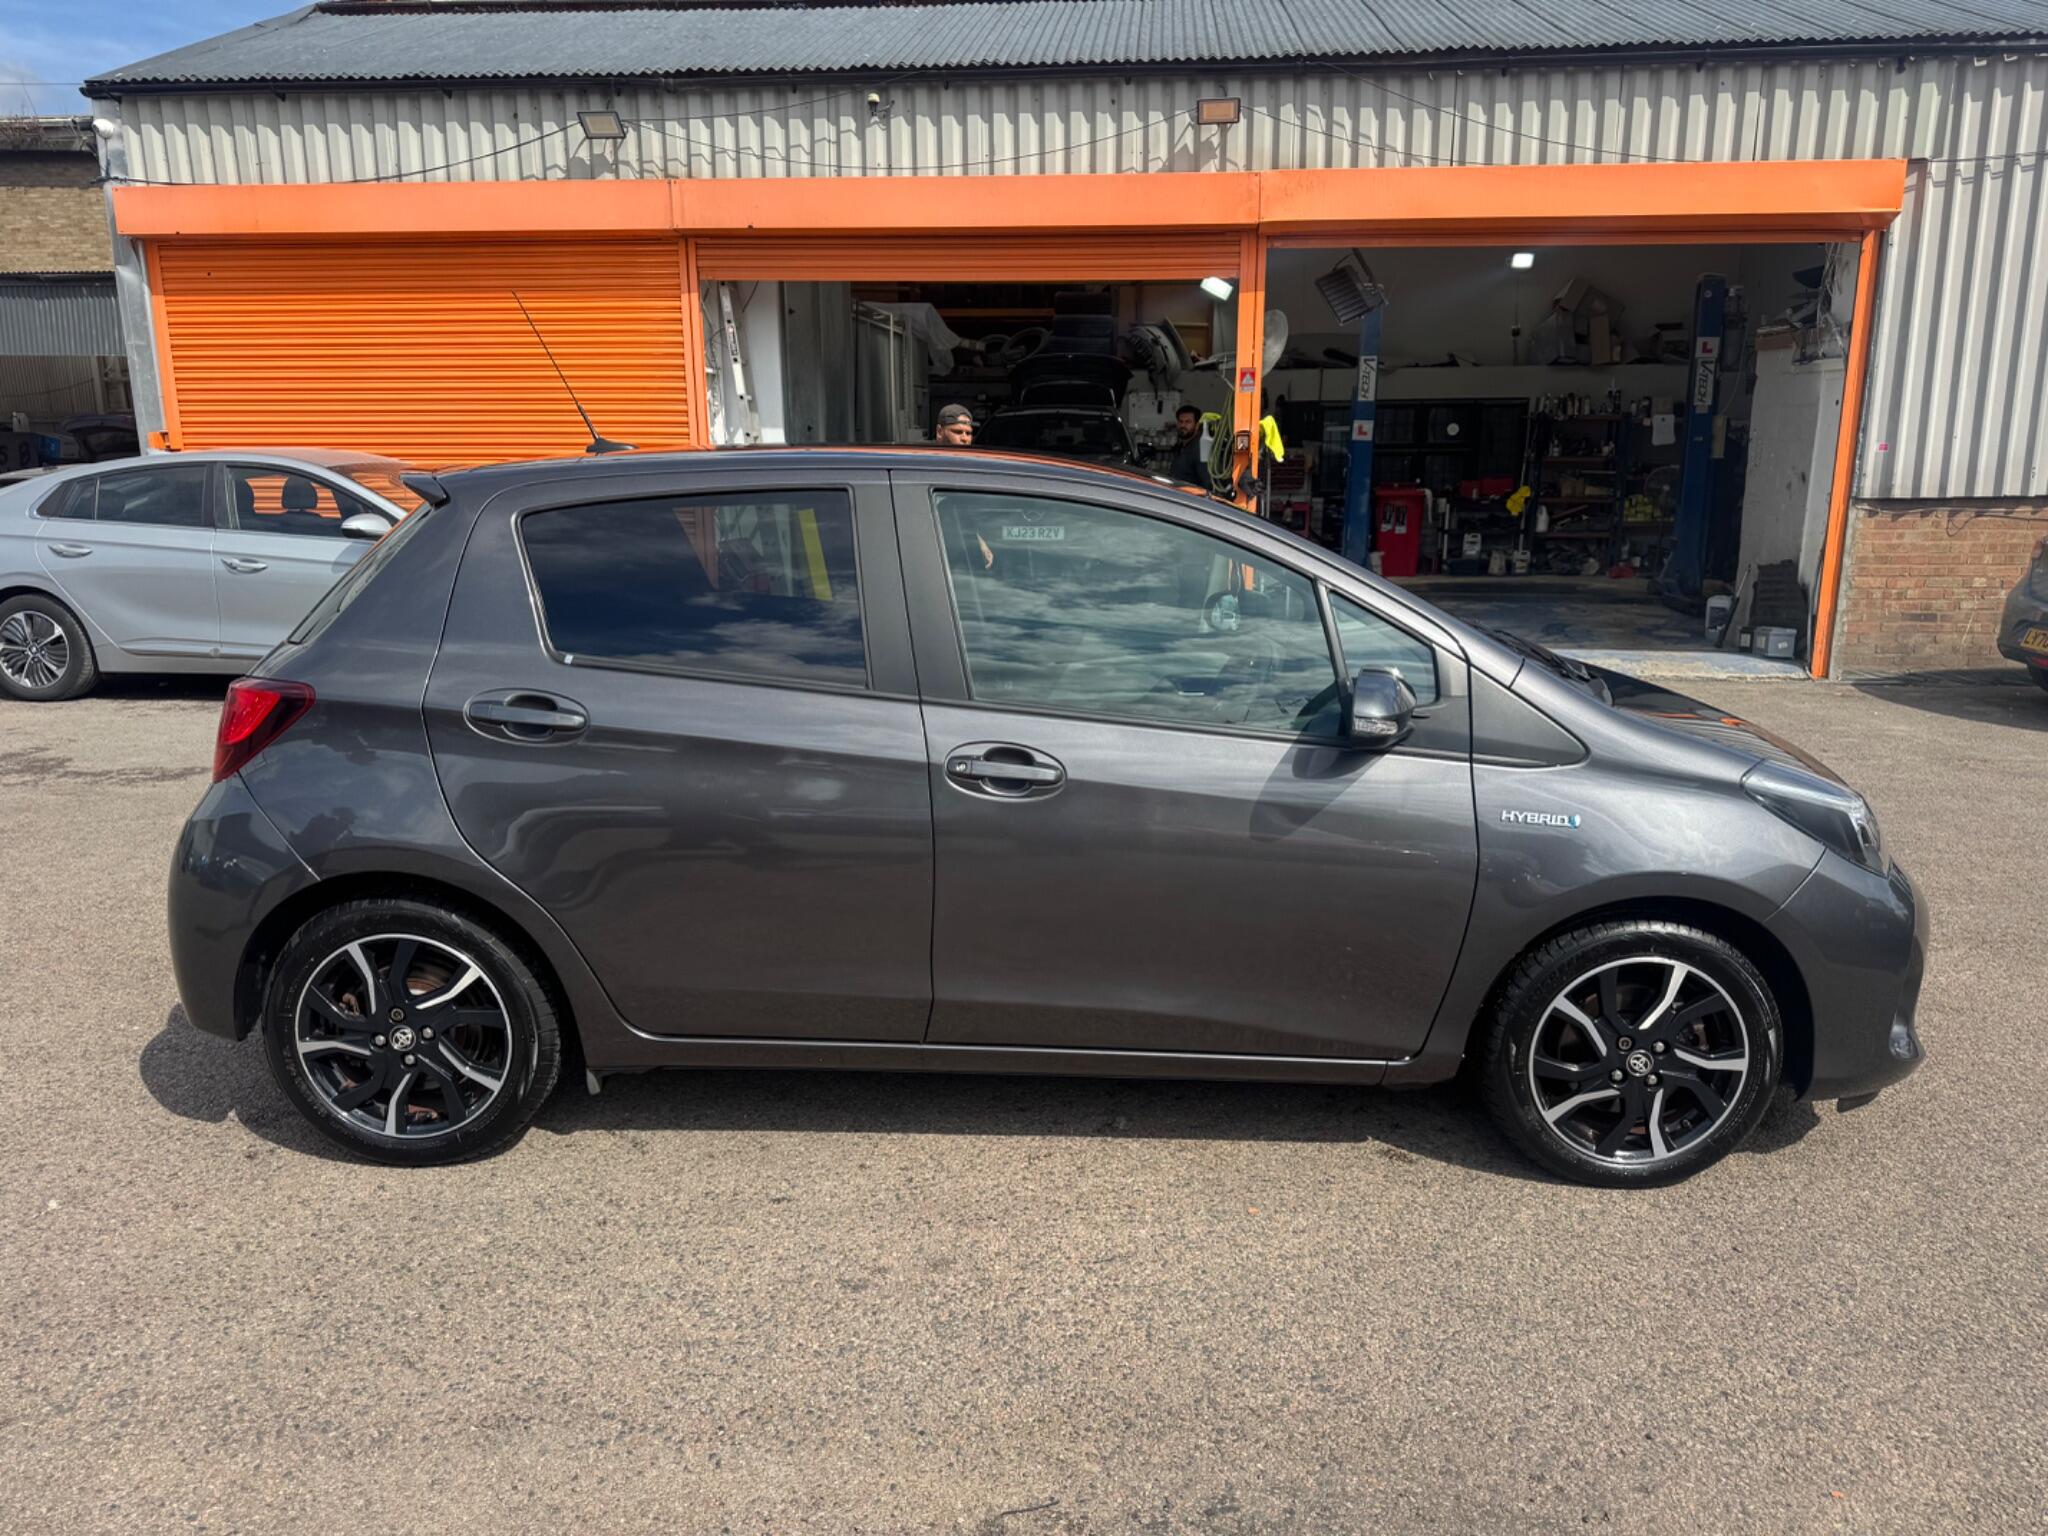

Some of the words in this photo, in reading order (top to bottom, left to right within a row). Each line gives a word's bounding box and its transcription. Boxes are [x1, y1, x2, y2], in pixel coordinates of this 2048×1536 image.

[1702, 341, 1713, 353] L
[1357, 424, 1368, 436] L
[1501, 808, 1569, 826] HYBRID
